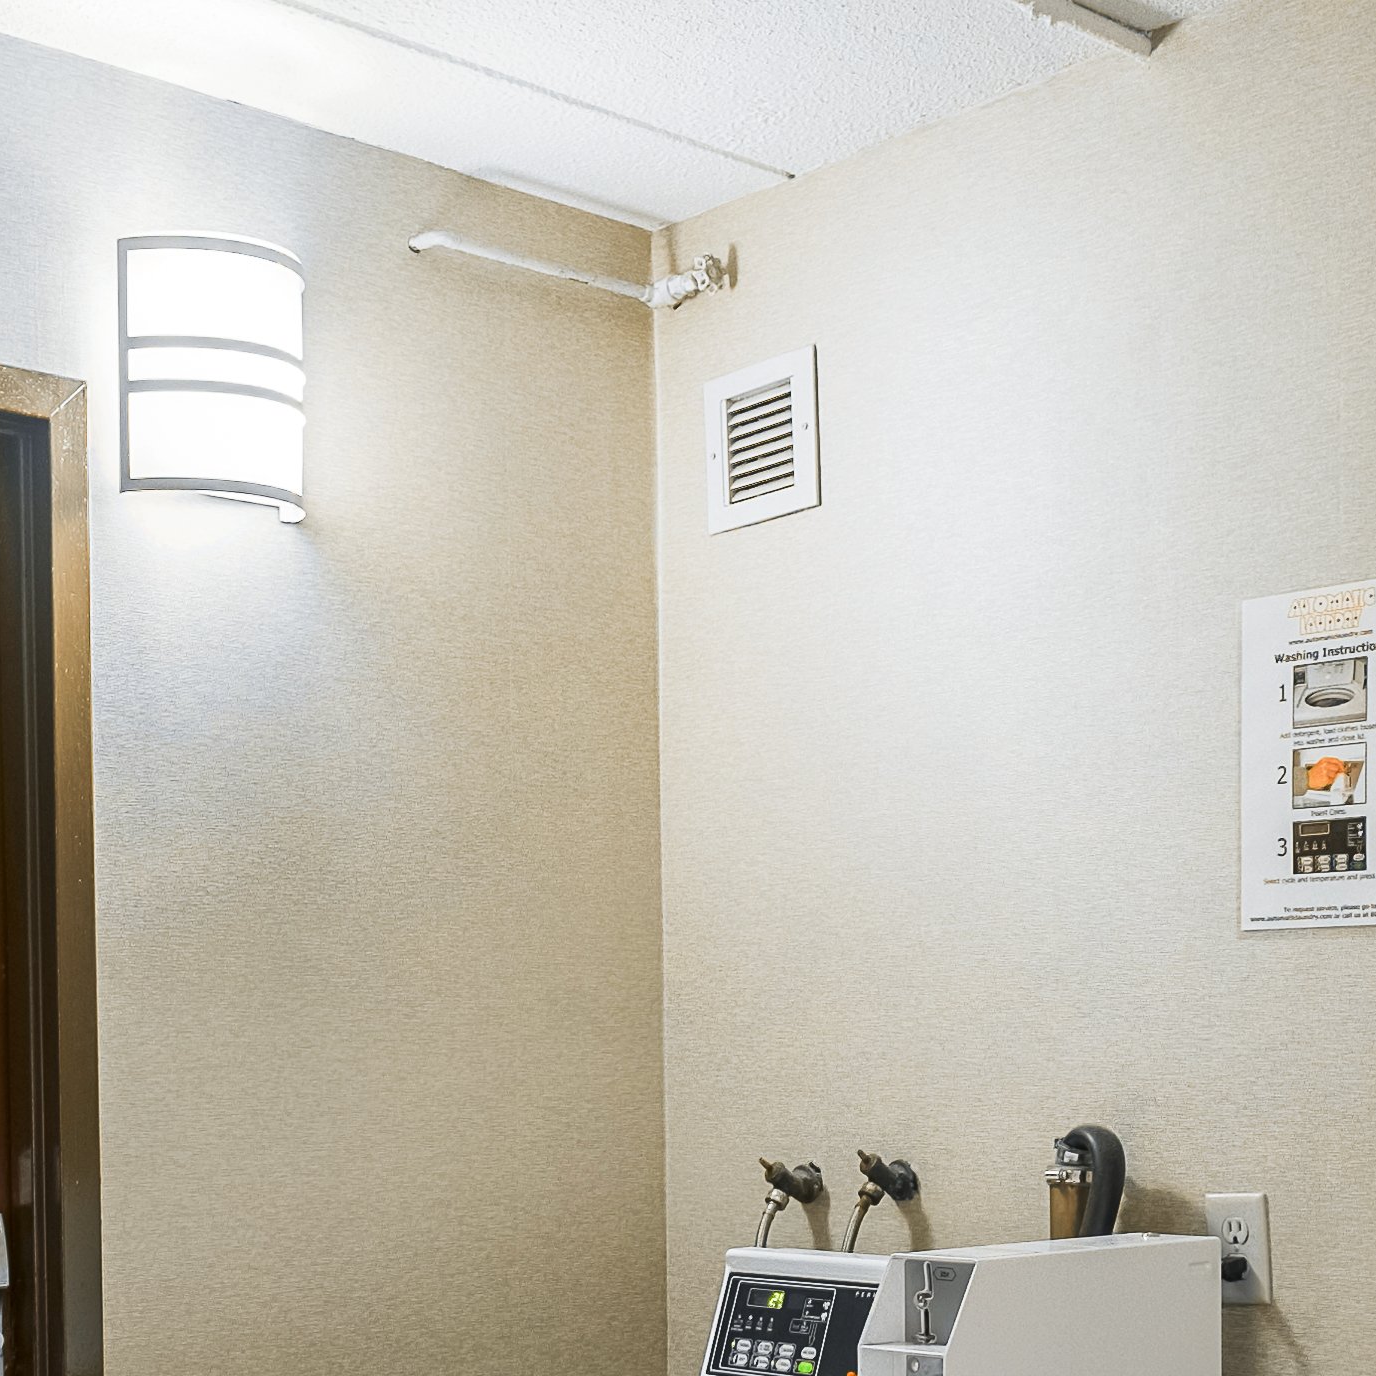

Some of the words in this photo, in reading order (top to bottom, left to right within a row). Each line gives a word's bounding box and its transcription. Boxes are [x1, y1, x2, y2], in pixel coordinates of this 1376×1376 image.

[1275, 650, 1319, 663] Washing
[1279, 684, 1287, 702] 1
[1277, 765, 1287, 784] 2
[1277, 838, 1287, 857] 3
